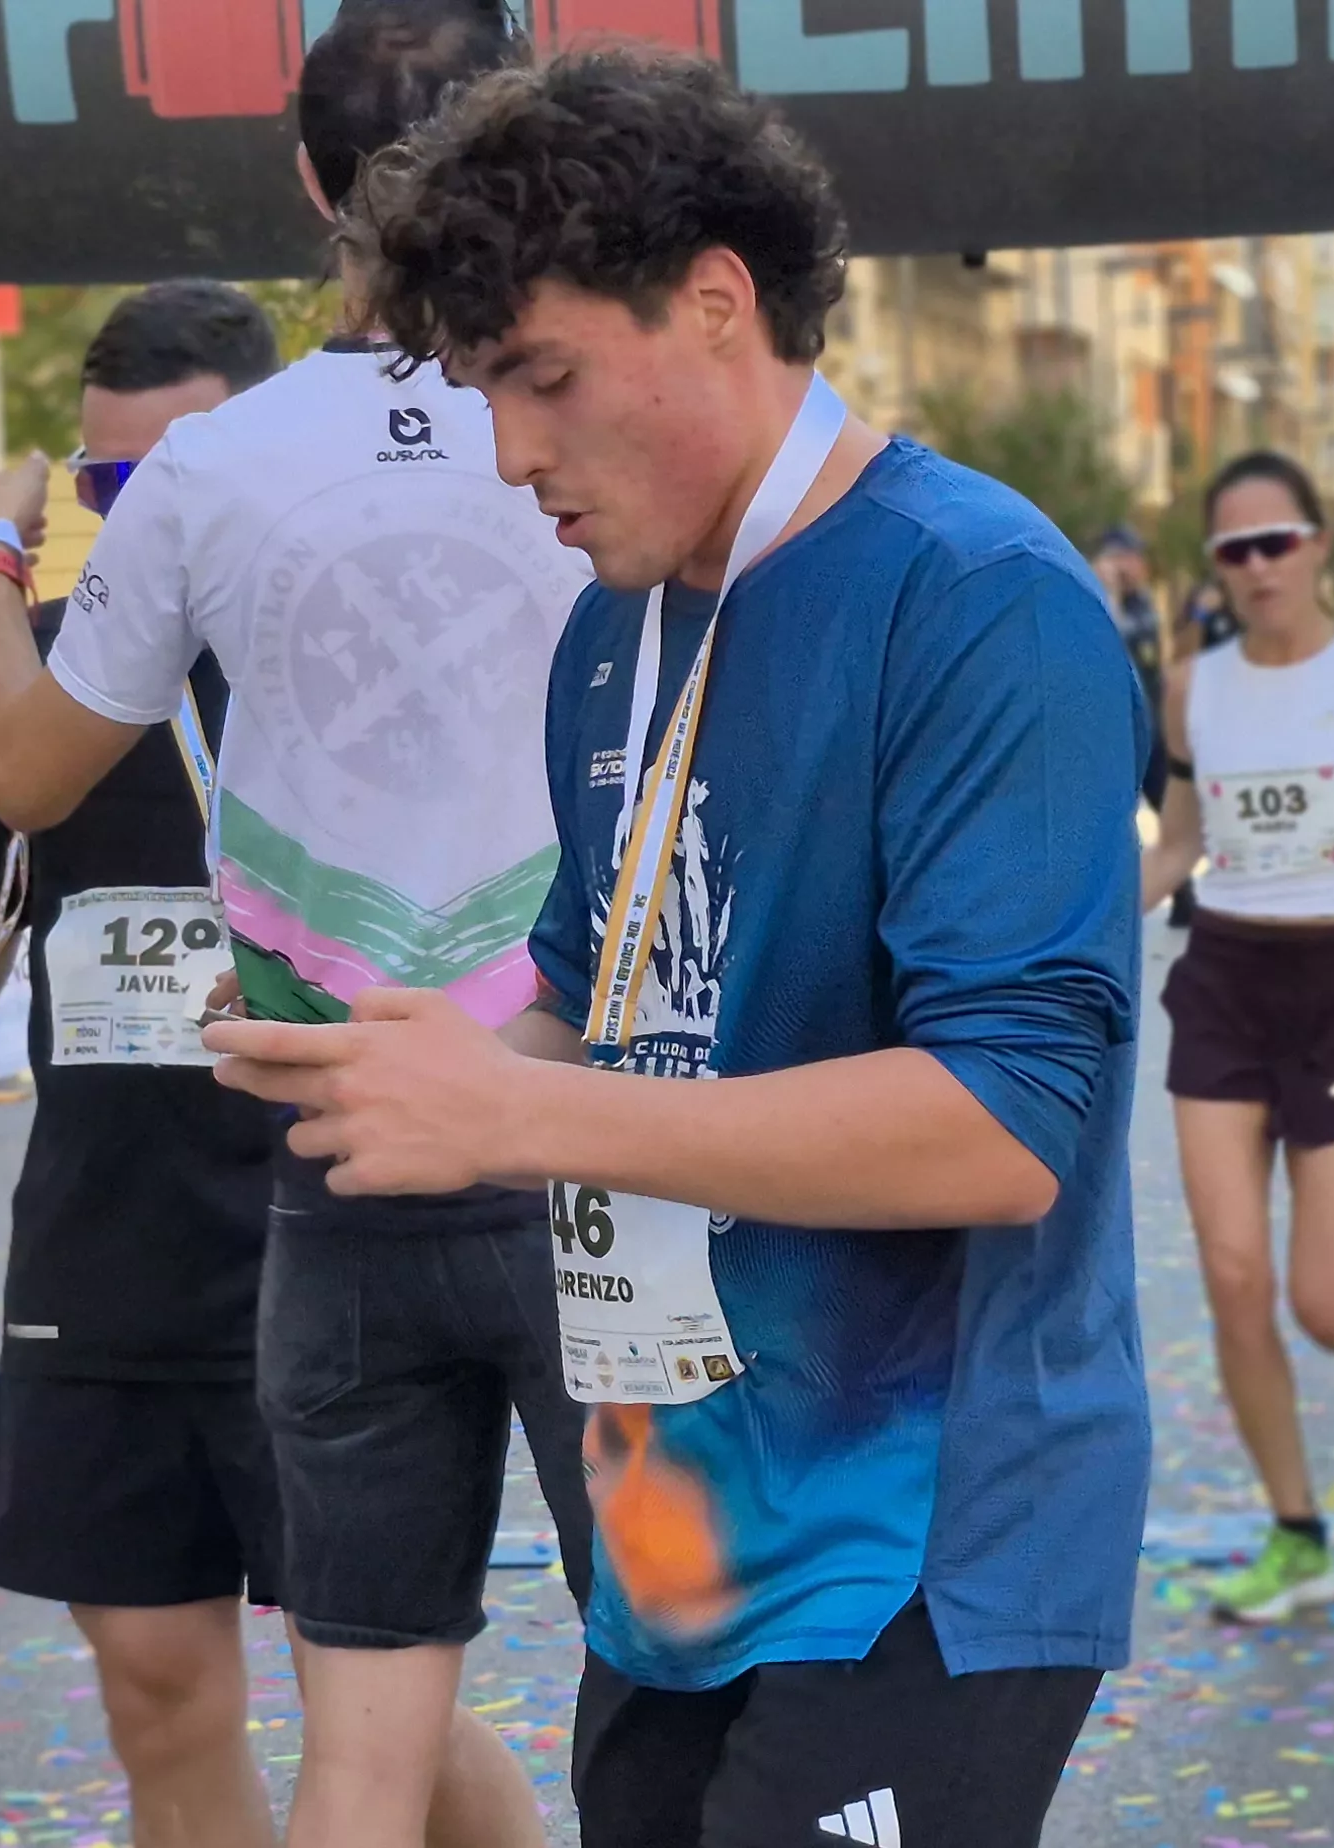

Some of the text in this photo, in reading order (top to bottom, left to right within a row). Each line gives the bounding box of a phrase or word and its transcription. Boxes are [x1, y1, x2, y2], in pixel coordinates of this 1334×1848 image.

[1236, 784, 1307, 820] 103
[100, 916, 220, 966] 129
[116, 975, 190, 993] JAVIE
[553, 1181, 615, 1259] 46
